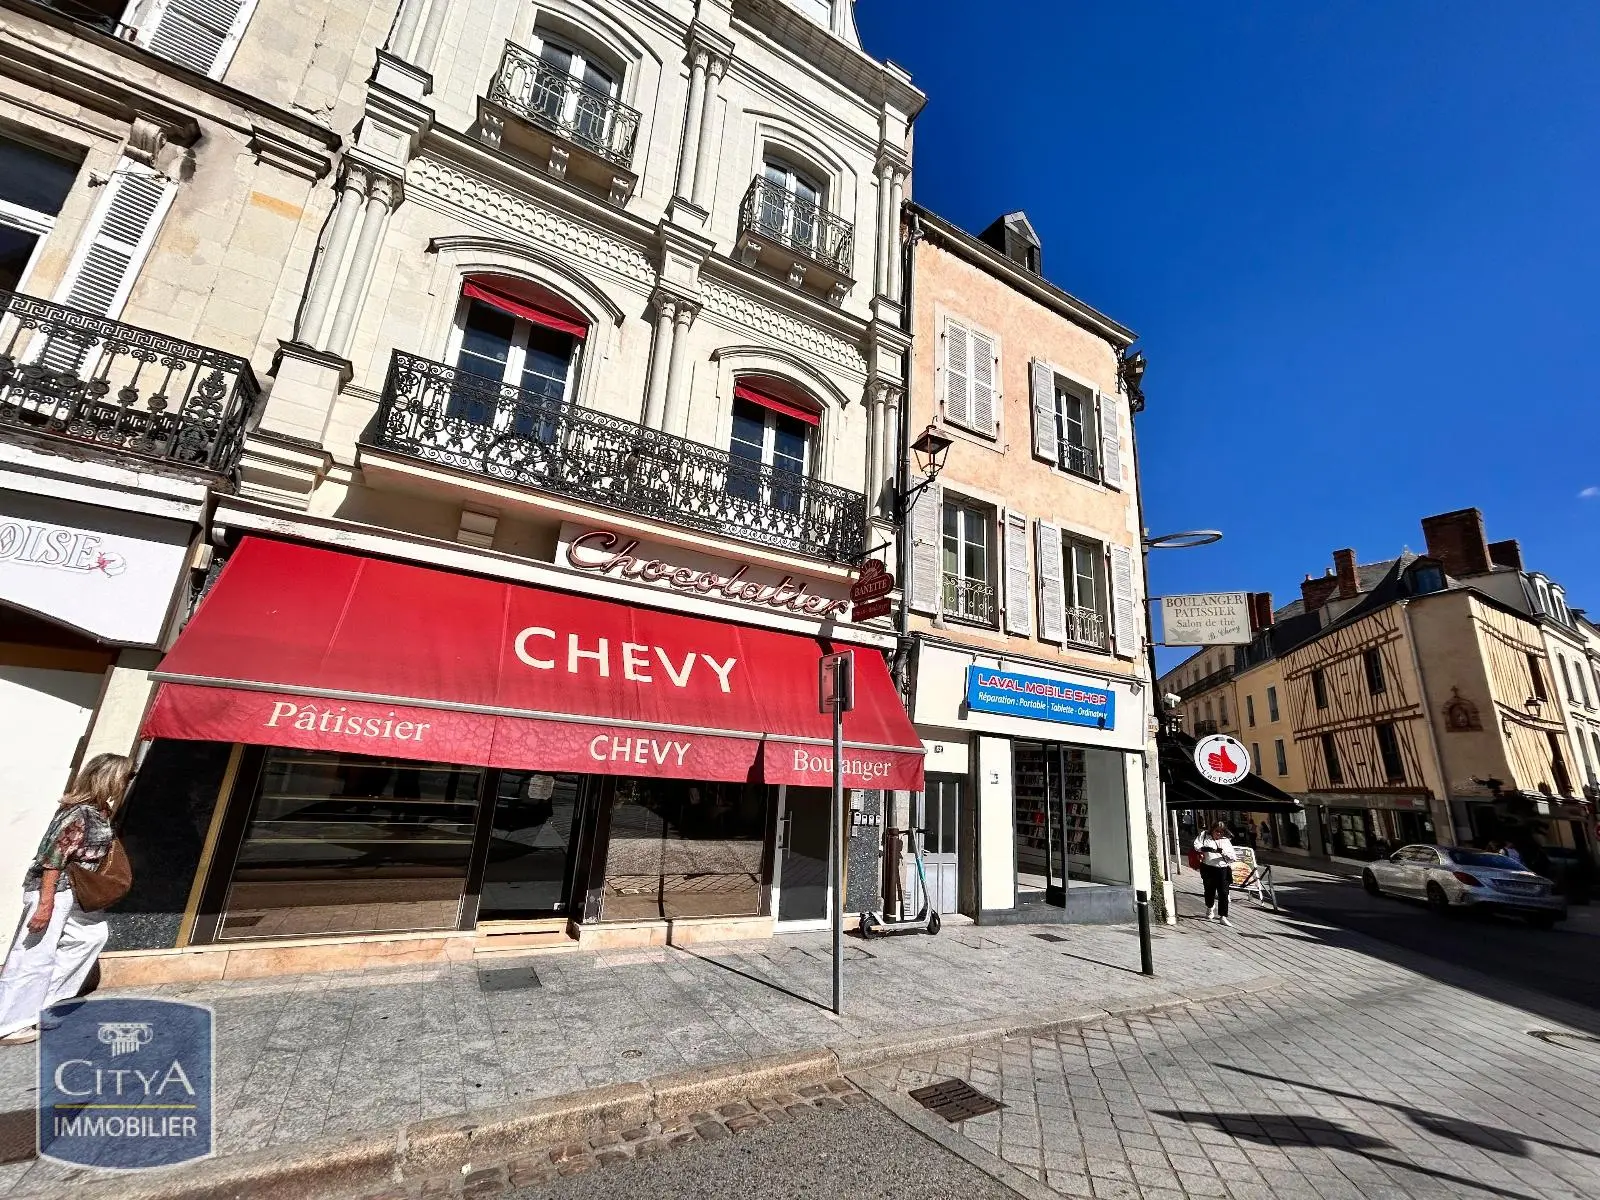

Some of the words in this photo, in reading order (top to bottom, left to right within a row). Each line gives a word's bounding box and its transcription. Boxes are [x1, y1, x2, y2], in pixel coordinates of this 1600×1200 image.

[566, 531, 849, 616] Chocolatier
[854, 579, 887, 597] BANETTE
[1166, 595, 1243, 607] BOULANGER
[1175, 607, 1236, 617] PATISSIER
[1177, 620, 1202, 628] Salon
[1205, 619, 1217, 627] de
[514, 626, 737, 693] CHEVY
[978, 673, 1024, 693] LAVAL
[1025, 681, 1073, 700] MOBILE
[1074, 690, 1107, 706] SHOP
[978, 691, 1016, 706] Réparation
[1019, 697, 1046, 710] Portable
[1051, 702, 1074, 714] Tablette
[263, 701, 431, 742] Pâtissier
[590, 734, 692, 766] CHEVY
[793, 749, 892, 781] Bouanger
[1218, 776, 1239, 784] Food
